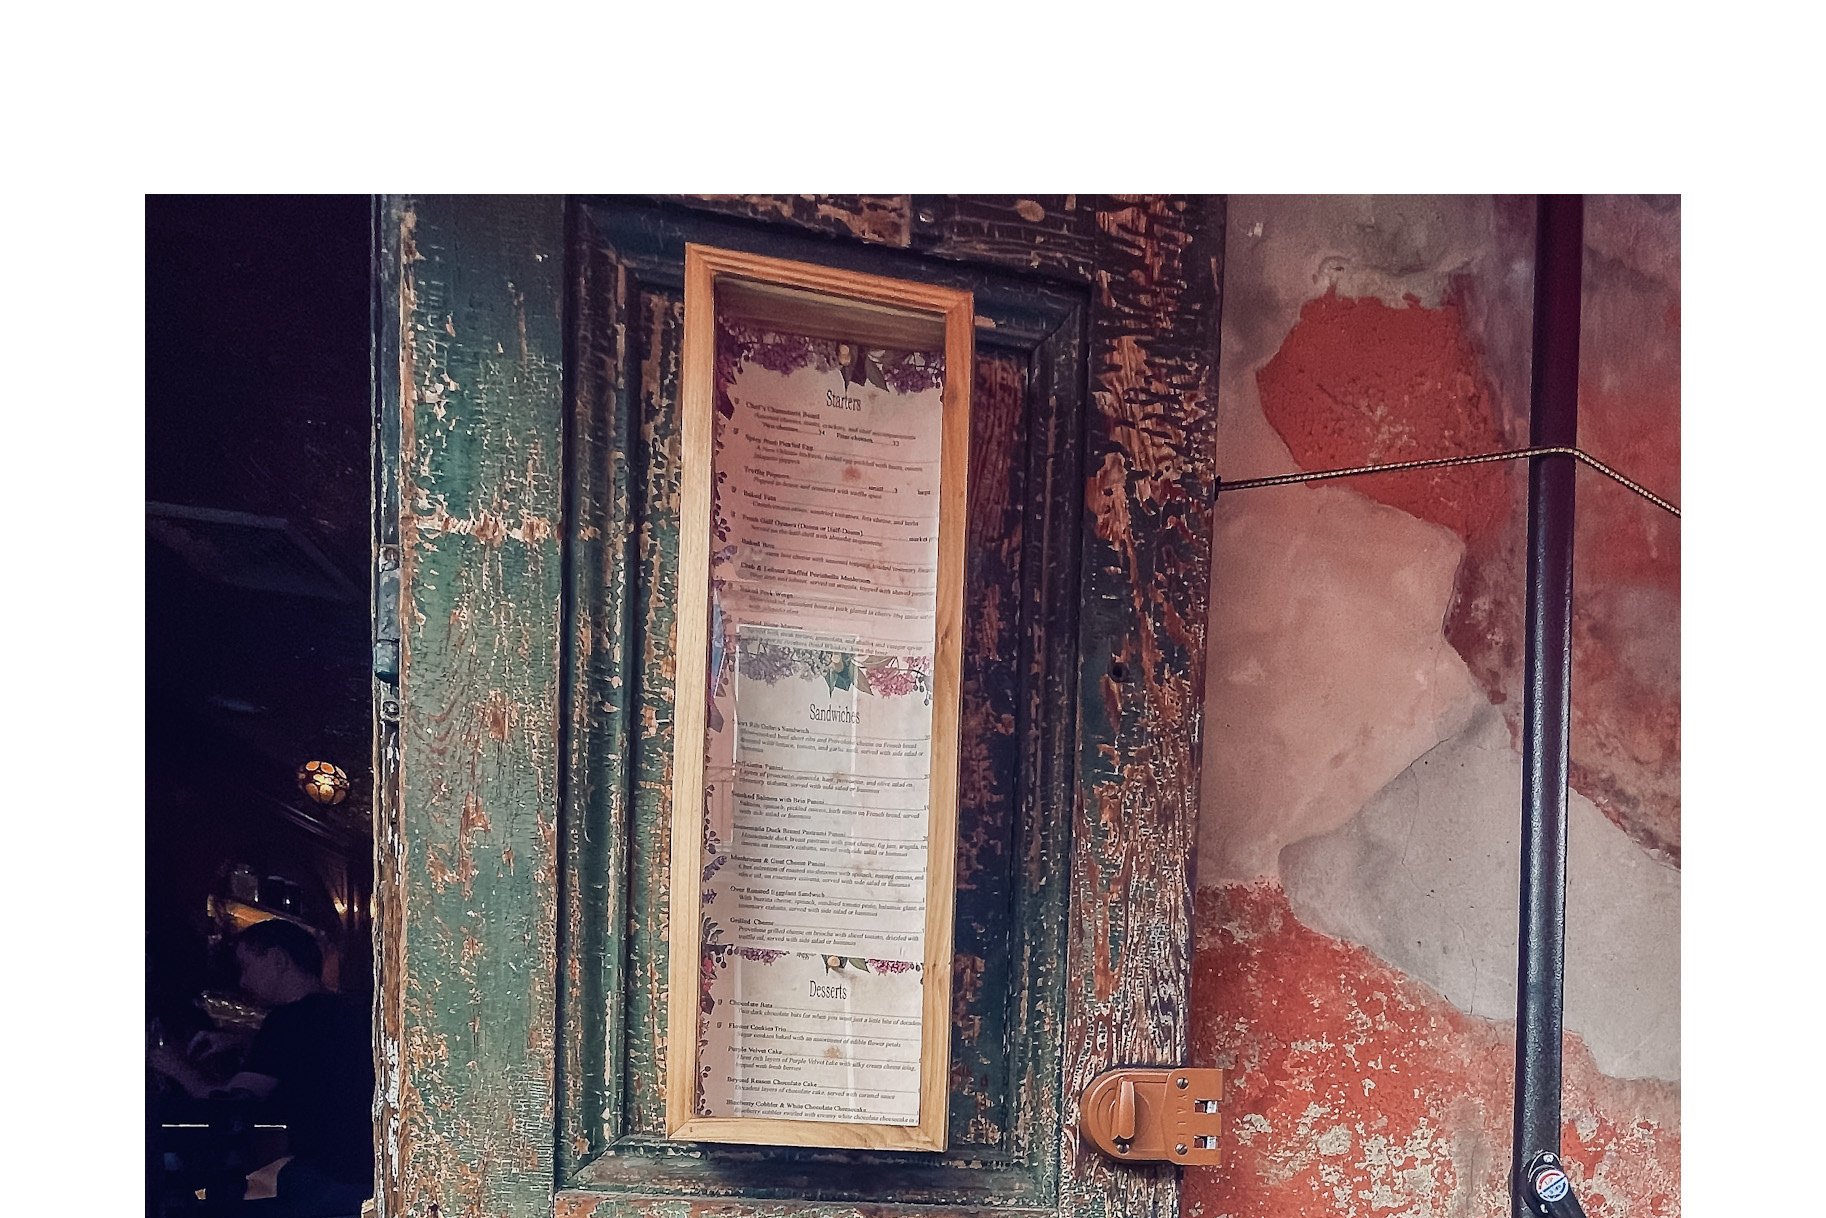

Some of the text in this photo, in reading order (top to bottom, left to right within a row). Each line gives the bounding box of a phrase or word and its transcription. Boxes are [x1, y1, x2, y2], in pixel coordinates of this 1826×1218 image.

[826, 389, 861, 411] Starters
[809, 702, 861, 725] Sandwiches
[809, 980, 848, 1000] Desserts
